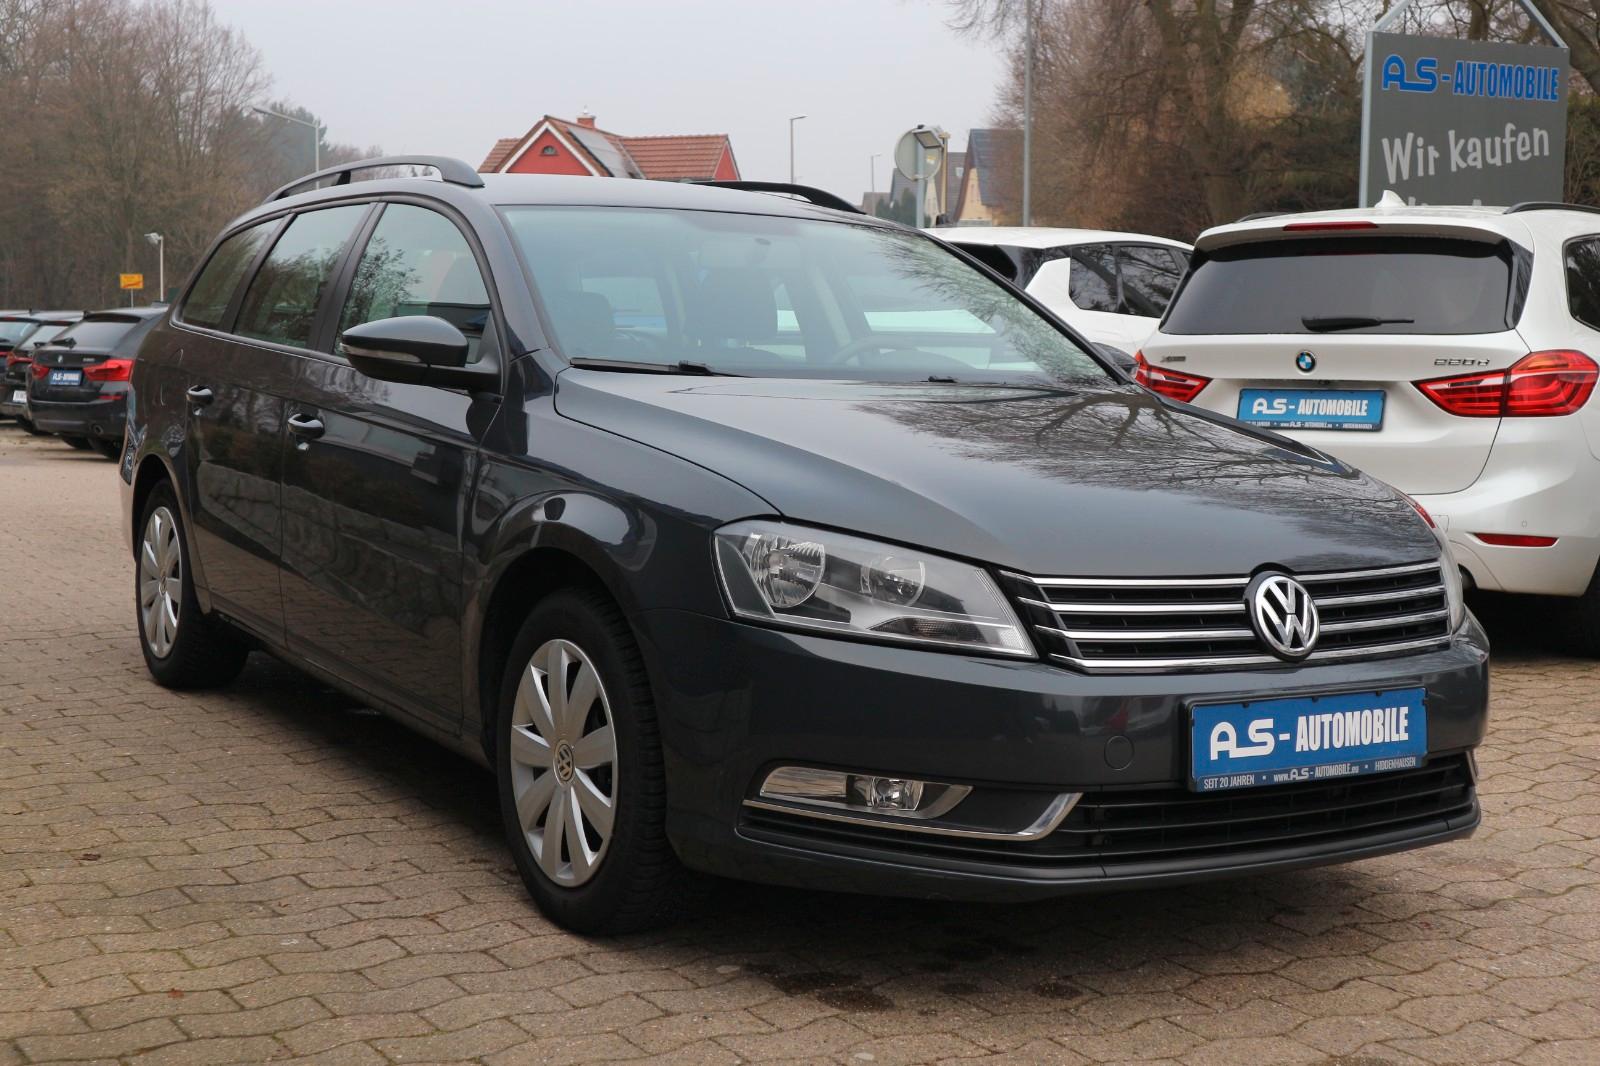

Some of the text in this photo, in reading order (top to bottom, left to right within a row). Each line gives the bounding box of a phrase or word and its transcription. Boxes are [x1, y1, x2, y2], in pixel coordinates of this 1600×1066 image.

[1382, 54, 1560, 102] AS-AUTOMOBILE
[1382, 122, 1550, 185] Wir kaufen
[1252, 397, 1369, 417] AS-AUTOMOBILE
[1210, 706, 1409, 761] AS-AUTOMOBILE
[1204, 776, 1219, 790] SEIT
[1219, 777, 1229, 788] 20
[1229, 774, 1255, 787] JAHREN
